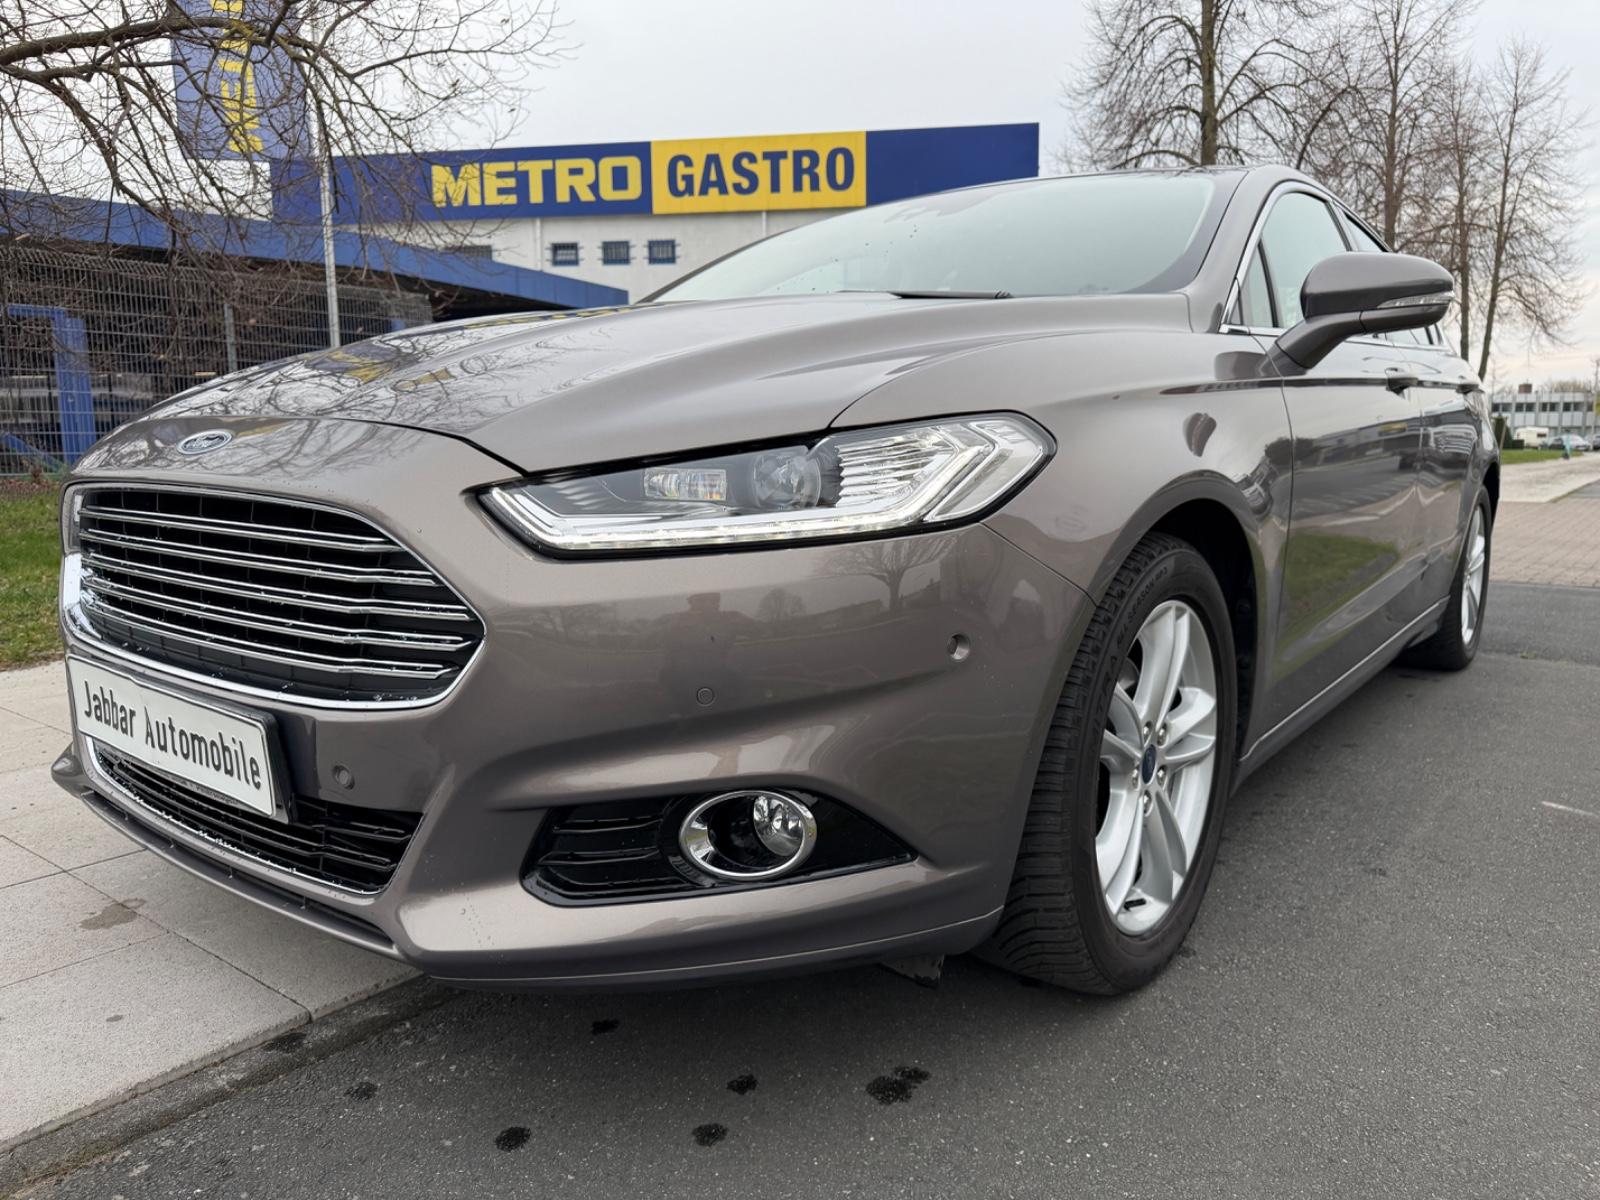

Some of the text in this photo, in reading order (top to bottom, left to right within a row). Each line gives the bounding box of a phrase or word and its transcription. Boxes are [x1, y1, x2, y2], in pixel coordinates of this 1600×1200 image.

[430, 147, 855, 208] METRO GASTRO
[84, 680, 136, 738] Jabbar
[144, 706, 262, 791] Automobile
